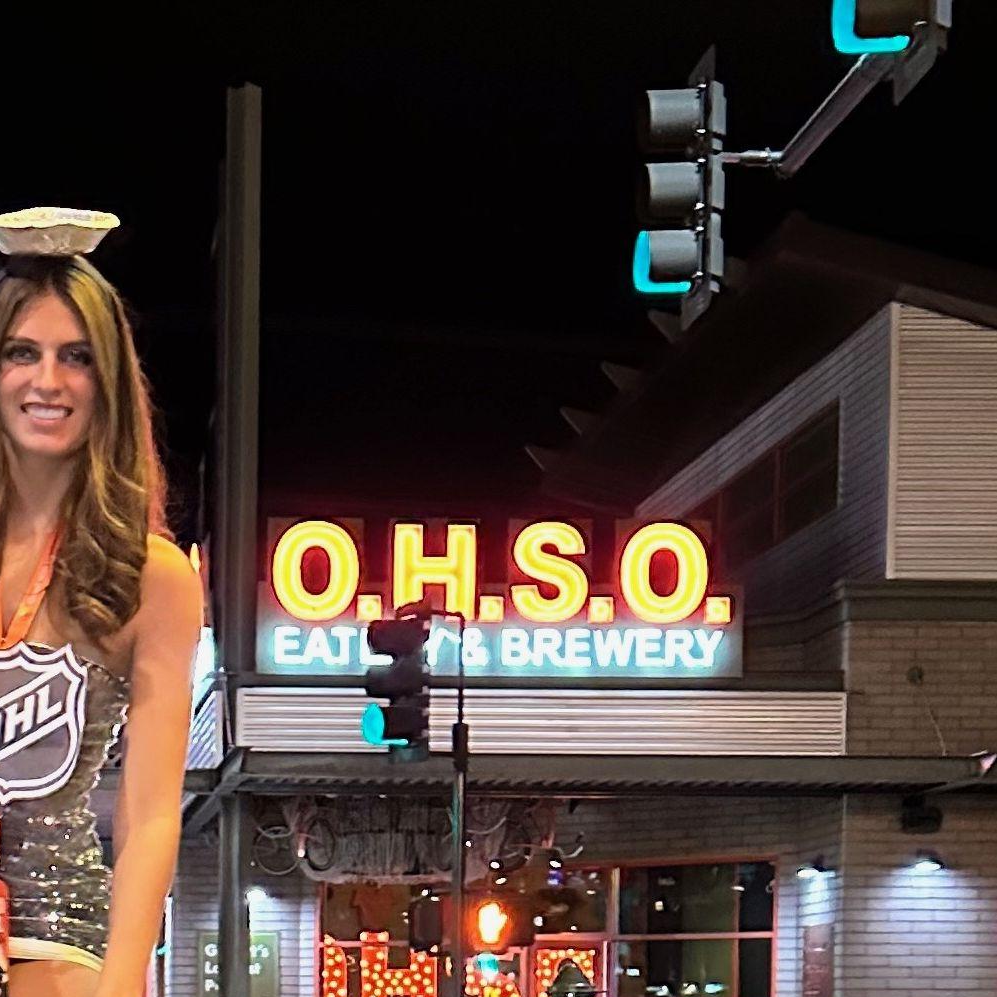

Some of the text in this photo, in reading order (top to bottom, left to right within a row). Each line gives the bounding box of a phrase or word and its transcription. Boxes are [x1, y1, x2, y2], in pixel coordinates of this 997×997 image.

[272, 520, 733, 624] O.H.S.O.
[272, 626, 725, 668] EATY & BREWERY
